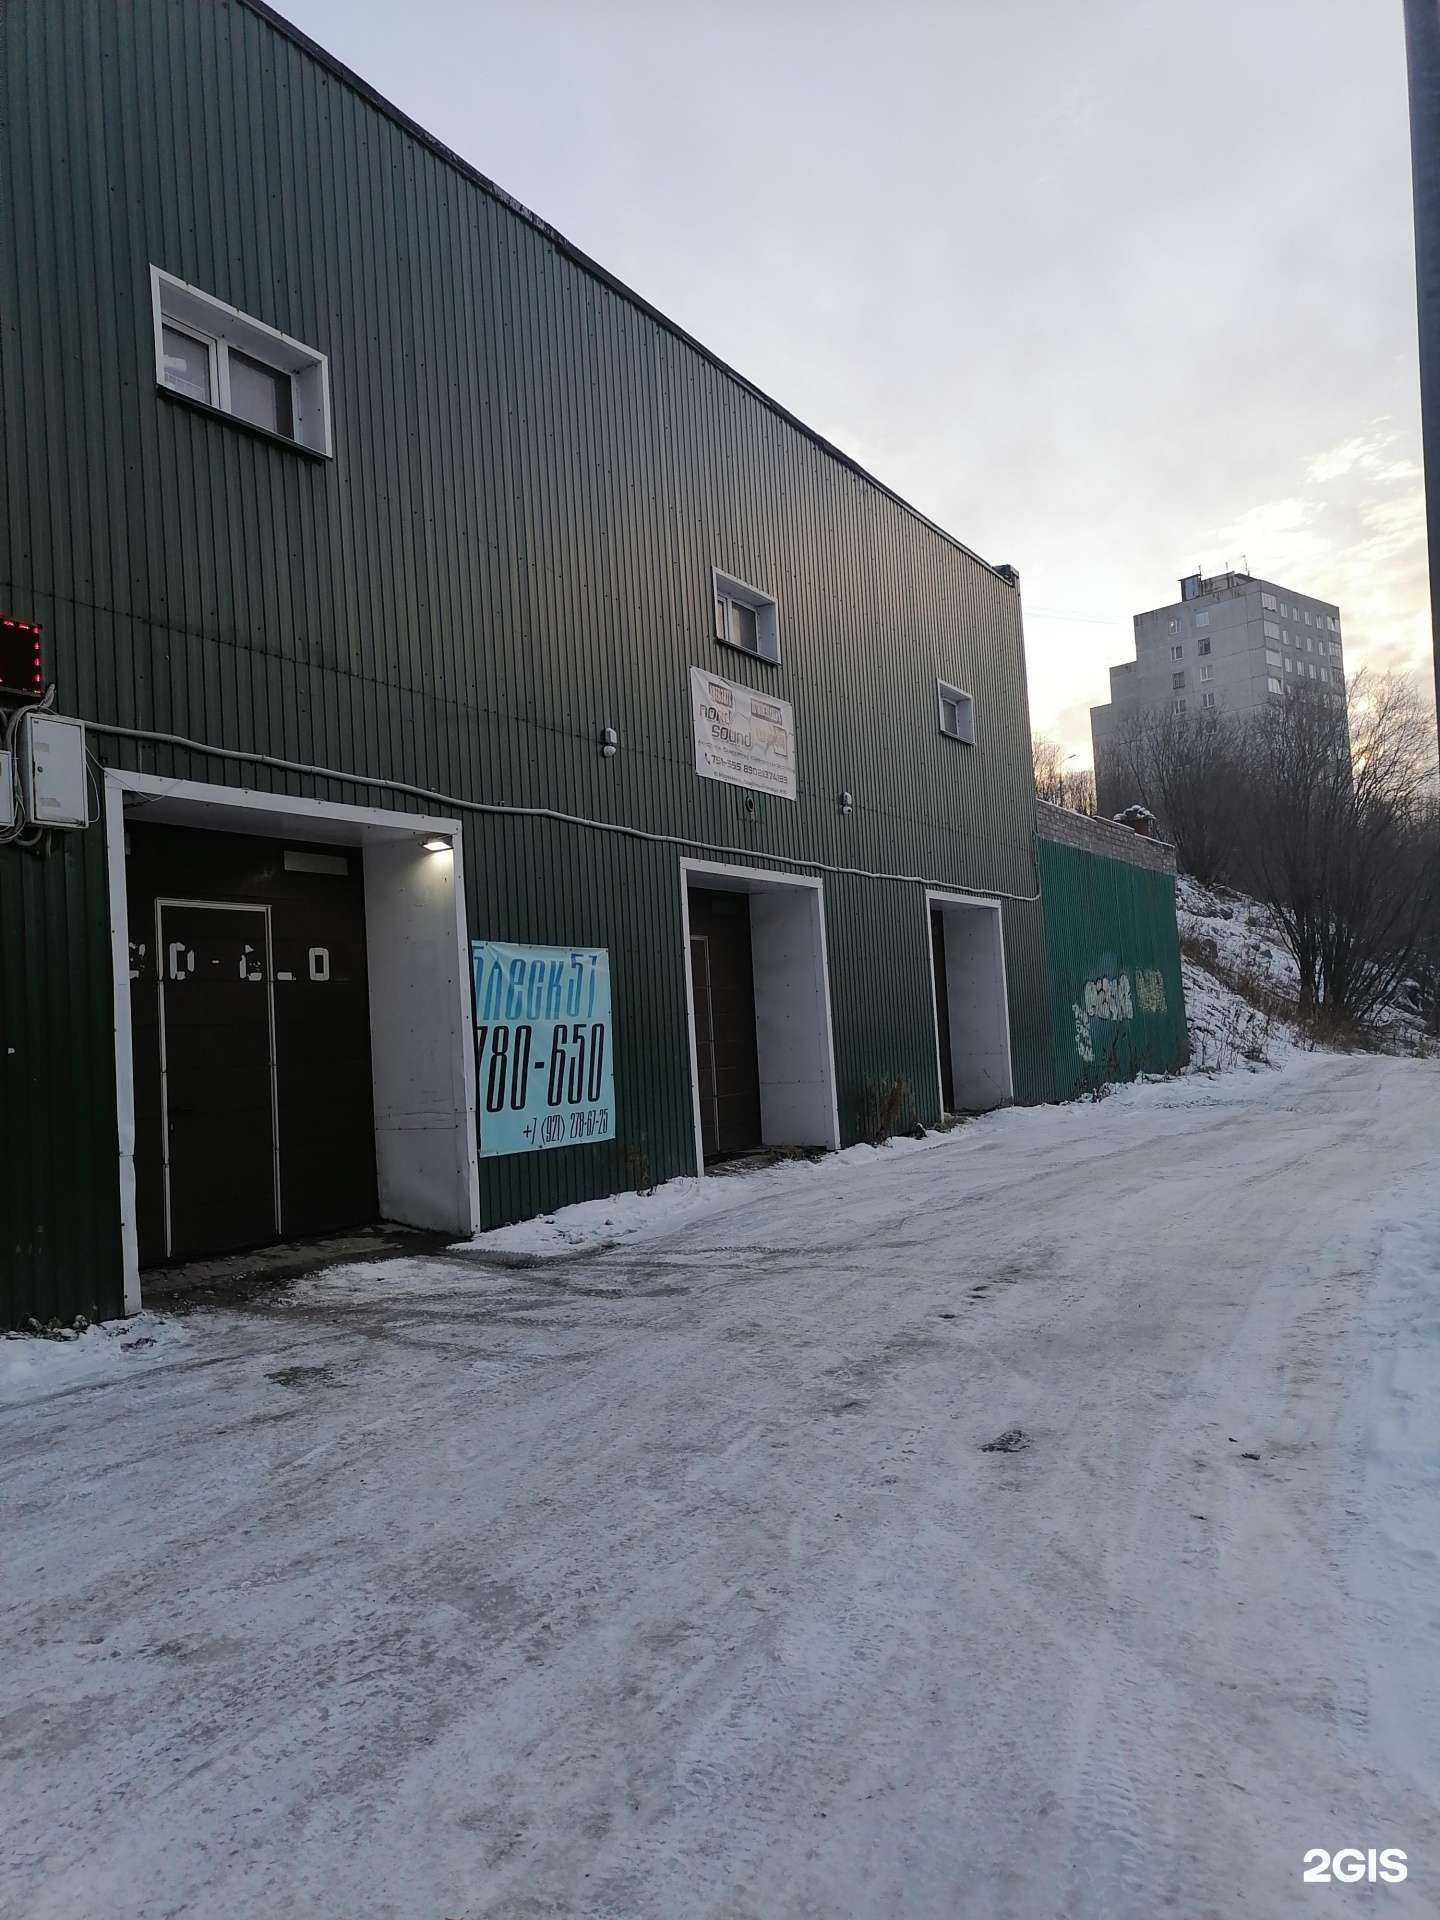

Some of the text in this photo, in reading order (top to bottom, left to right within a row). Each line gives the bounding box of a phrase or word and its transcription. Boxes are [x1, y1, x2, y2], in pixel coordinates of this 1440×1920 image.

[711, 724, 751, 747] sound
[523, 1117, 537, 1144] +7
[541, 1114, 565, 1145] (921)
